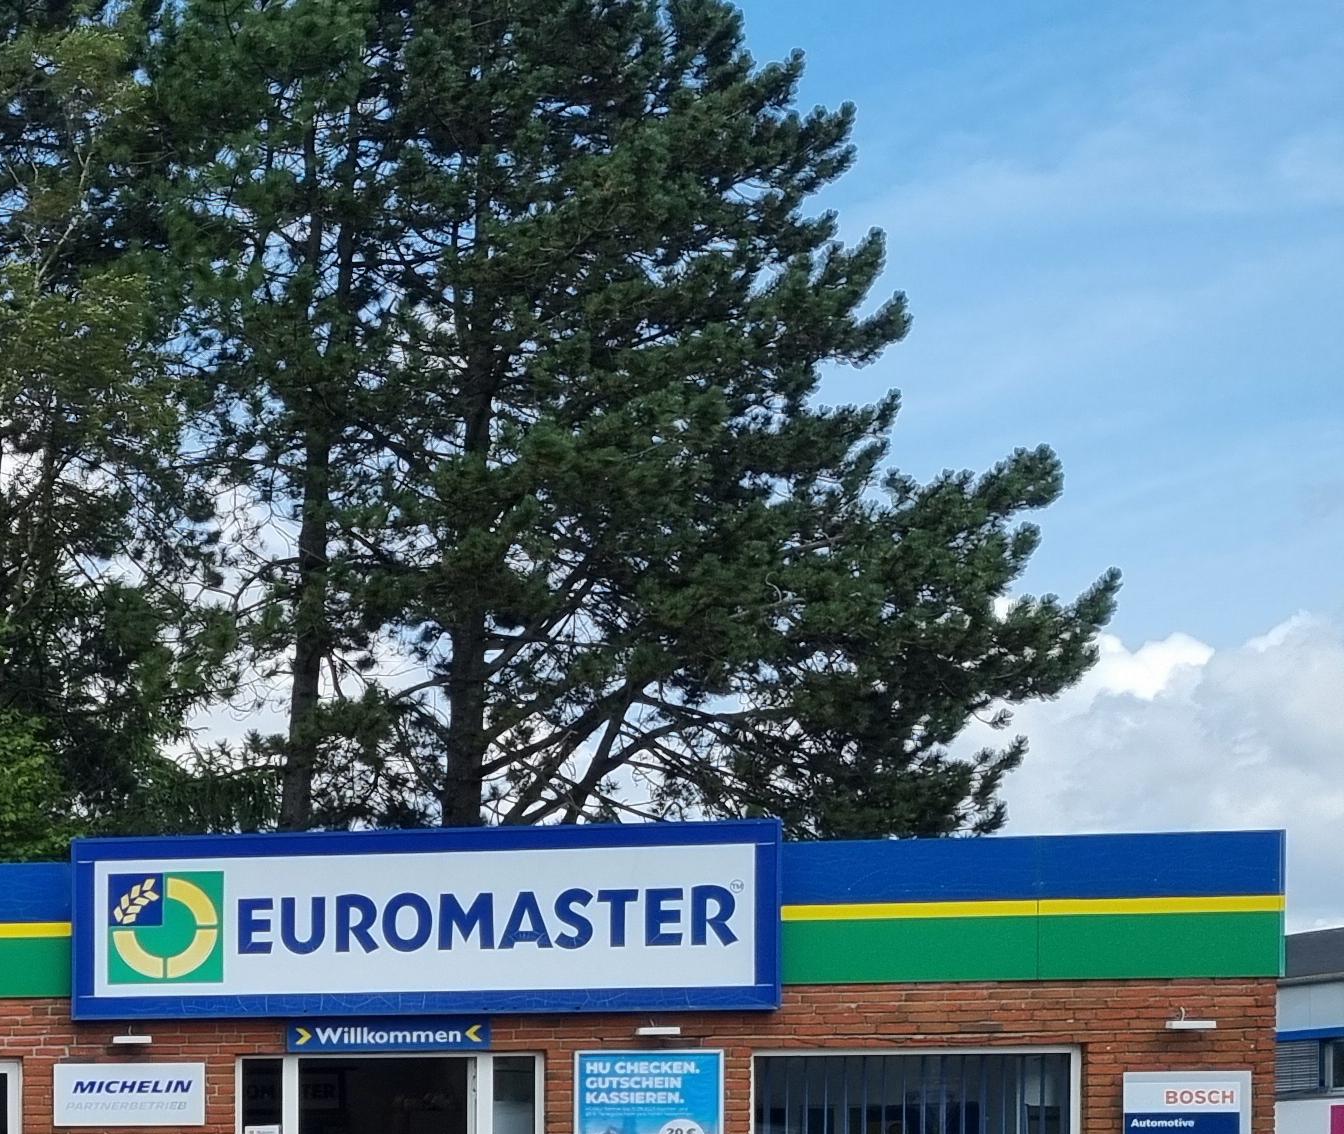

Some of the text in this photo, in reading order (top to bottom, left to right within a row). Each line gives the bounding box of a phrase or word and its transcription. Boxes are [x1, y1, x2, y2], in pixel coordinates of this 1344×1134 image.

[237, 884, 739, 955] EUROMASTER
[315, 1027, 461, 1044] Willkommen
[585, 1061, 700, 1075] HU CHECKEN.
[72, 1080, 193, 1094] MICHELIN
[585, 1076, 682, 1089] GUTSCHEIN
[585, 1091, 684, 1104] KASSIEREN.
[1165, 1090, 1234, 1105] BOSCH
[65, 1101, 188, 1111] PARTNERBETRIEB
[1130, 1118, 1195, 1128] Automotive
